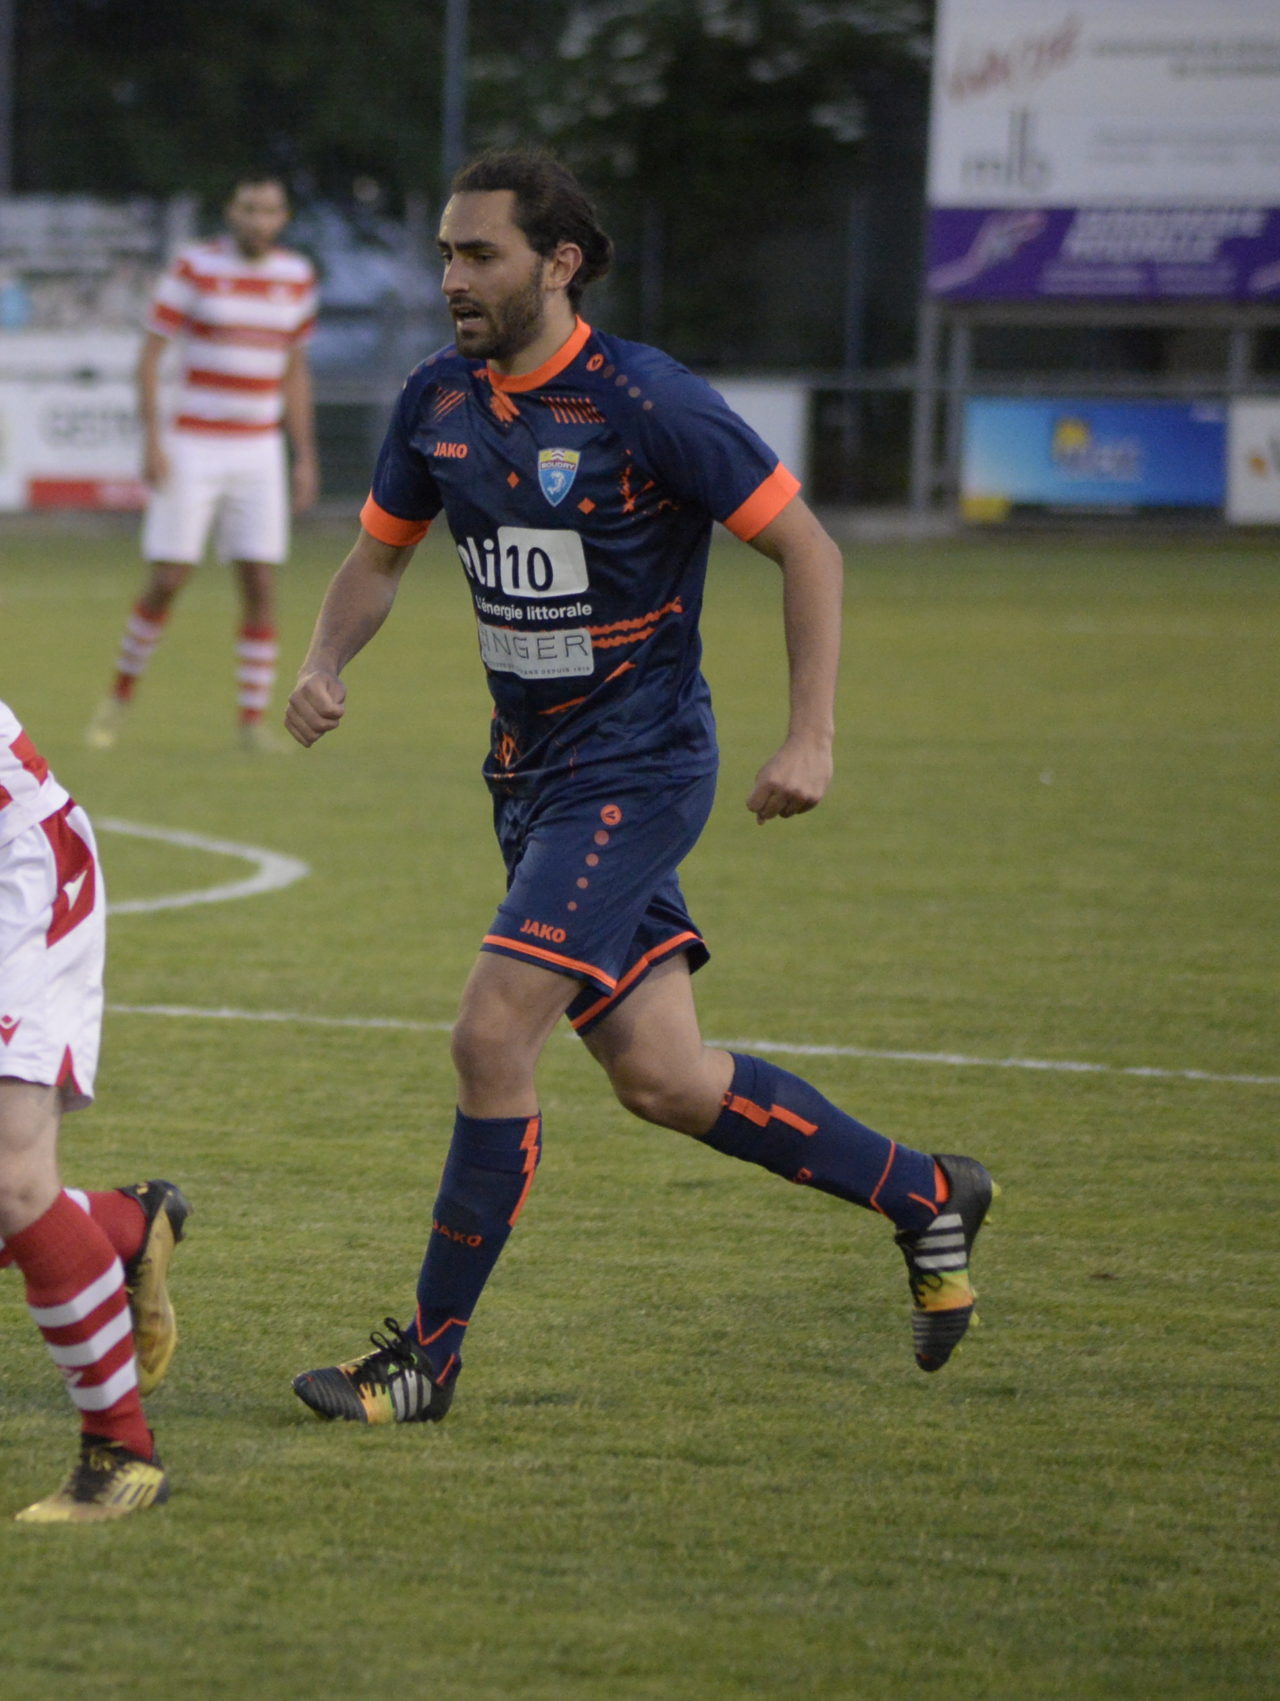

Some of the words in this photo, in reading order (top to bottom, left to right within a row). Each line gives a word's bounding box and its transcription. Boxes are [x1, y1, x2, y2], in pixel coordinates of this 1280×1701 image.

[433, 441, 468, 459] JAKO
[541, 460, 577, 471] BOUDRY
[527, 602, 593, 620] littorale
[520, 919, 567, 944] JAKO
[432, 1219, 482, 1248] JAKO
